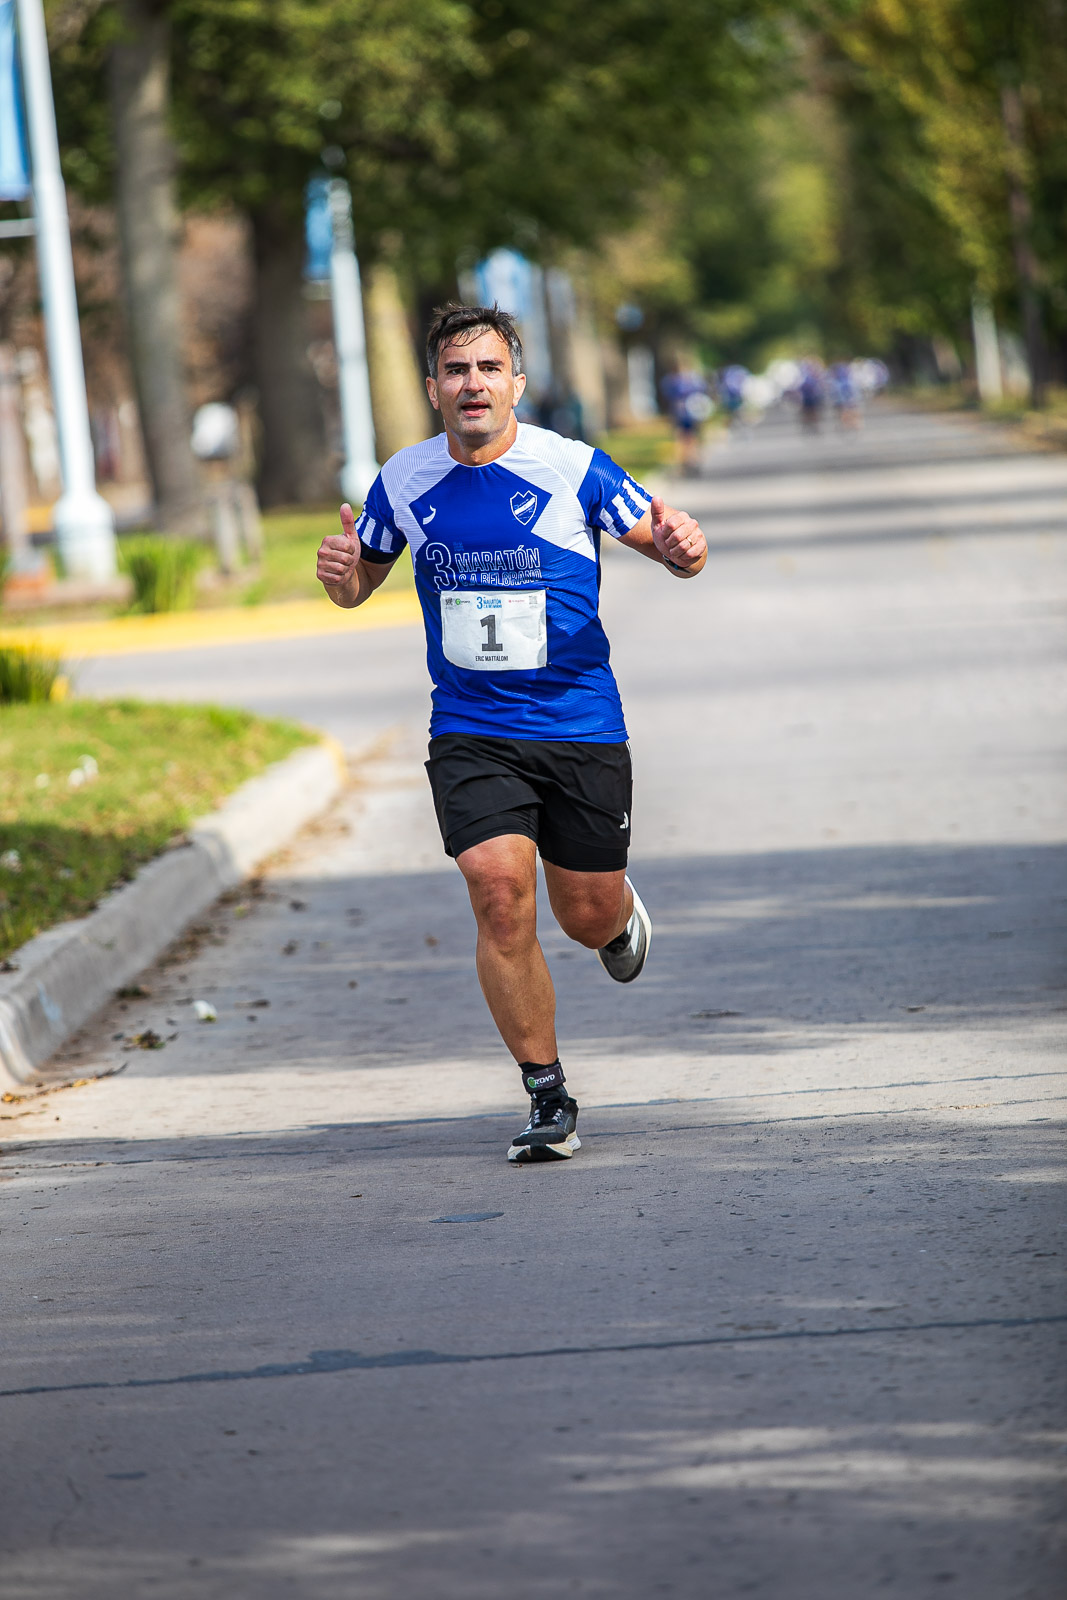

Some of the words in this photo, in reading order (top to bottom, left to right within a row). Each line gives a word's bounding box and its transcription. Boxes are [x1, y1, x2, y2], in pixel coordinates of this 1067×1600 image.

[425, 542, 458, 591] 3
[454, 544, 541, 573] MARATÓN
[480, 614, 503, 652] 1
